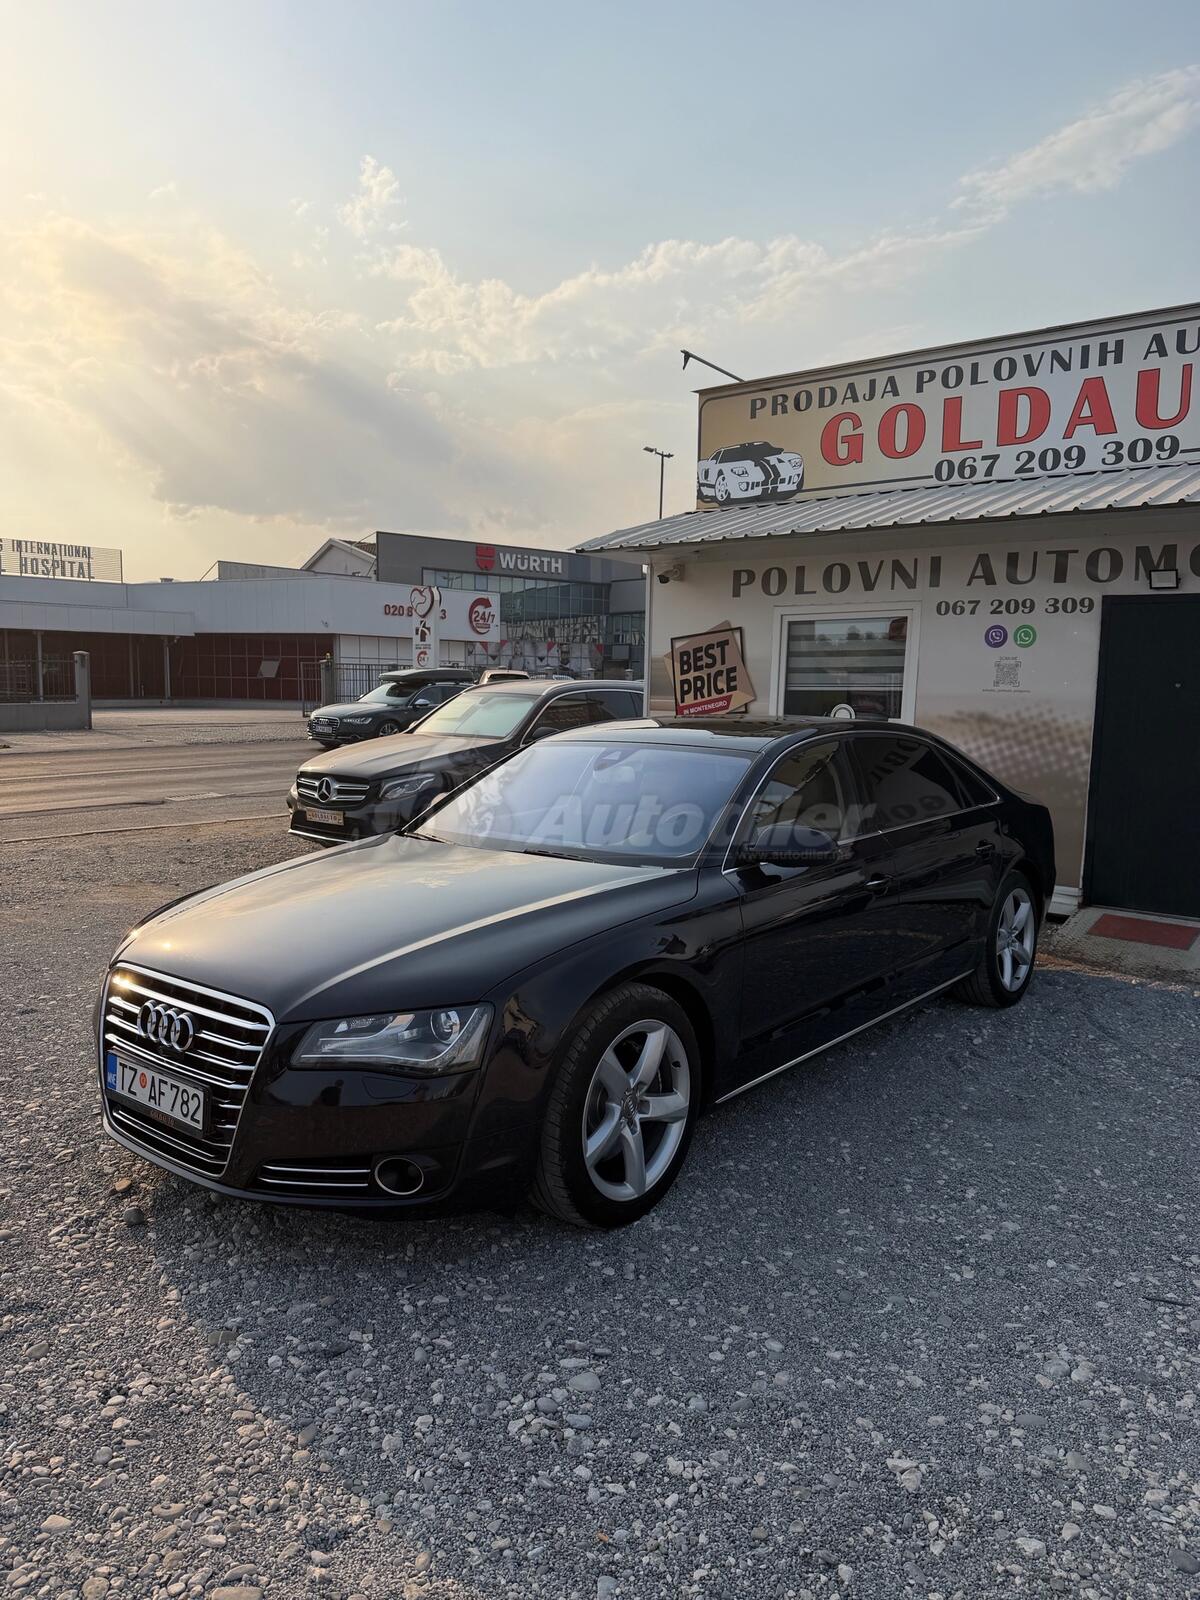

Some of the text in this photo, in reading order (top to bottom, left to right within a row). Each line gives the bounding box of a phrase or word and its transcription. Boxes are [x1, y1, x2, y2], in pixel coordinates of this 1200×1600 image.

[750, 375, 900, 419] PRODAJA
[916, 339, 1124, 393] POLOVNIH
[820, 363, 1193, 466] GOLDAU
[934, 435, 1180, 481] 067 209 309
[12, 539, 94, 560] INTERNATIONAL
[499, 552, 562, 574] WÜRTH
[20, 557, 95, 579] HOSPITAL
[732, 544, 1200, 597] POLOVNI AUTOM
[384, 603, 404, 617] 020
[473, 610, 495, 623] 24/7
[936, 597, 1094, 615] 067 209 309
[679, 638, 729, 676] BEST
[680, 666, 737, 704] PRICE
[690, 700, 727, 713] MONTENEGRO
[119, 1062, 137, 1097] TZ
[148, 1075, 201, 1125] AF782
